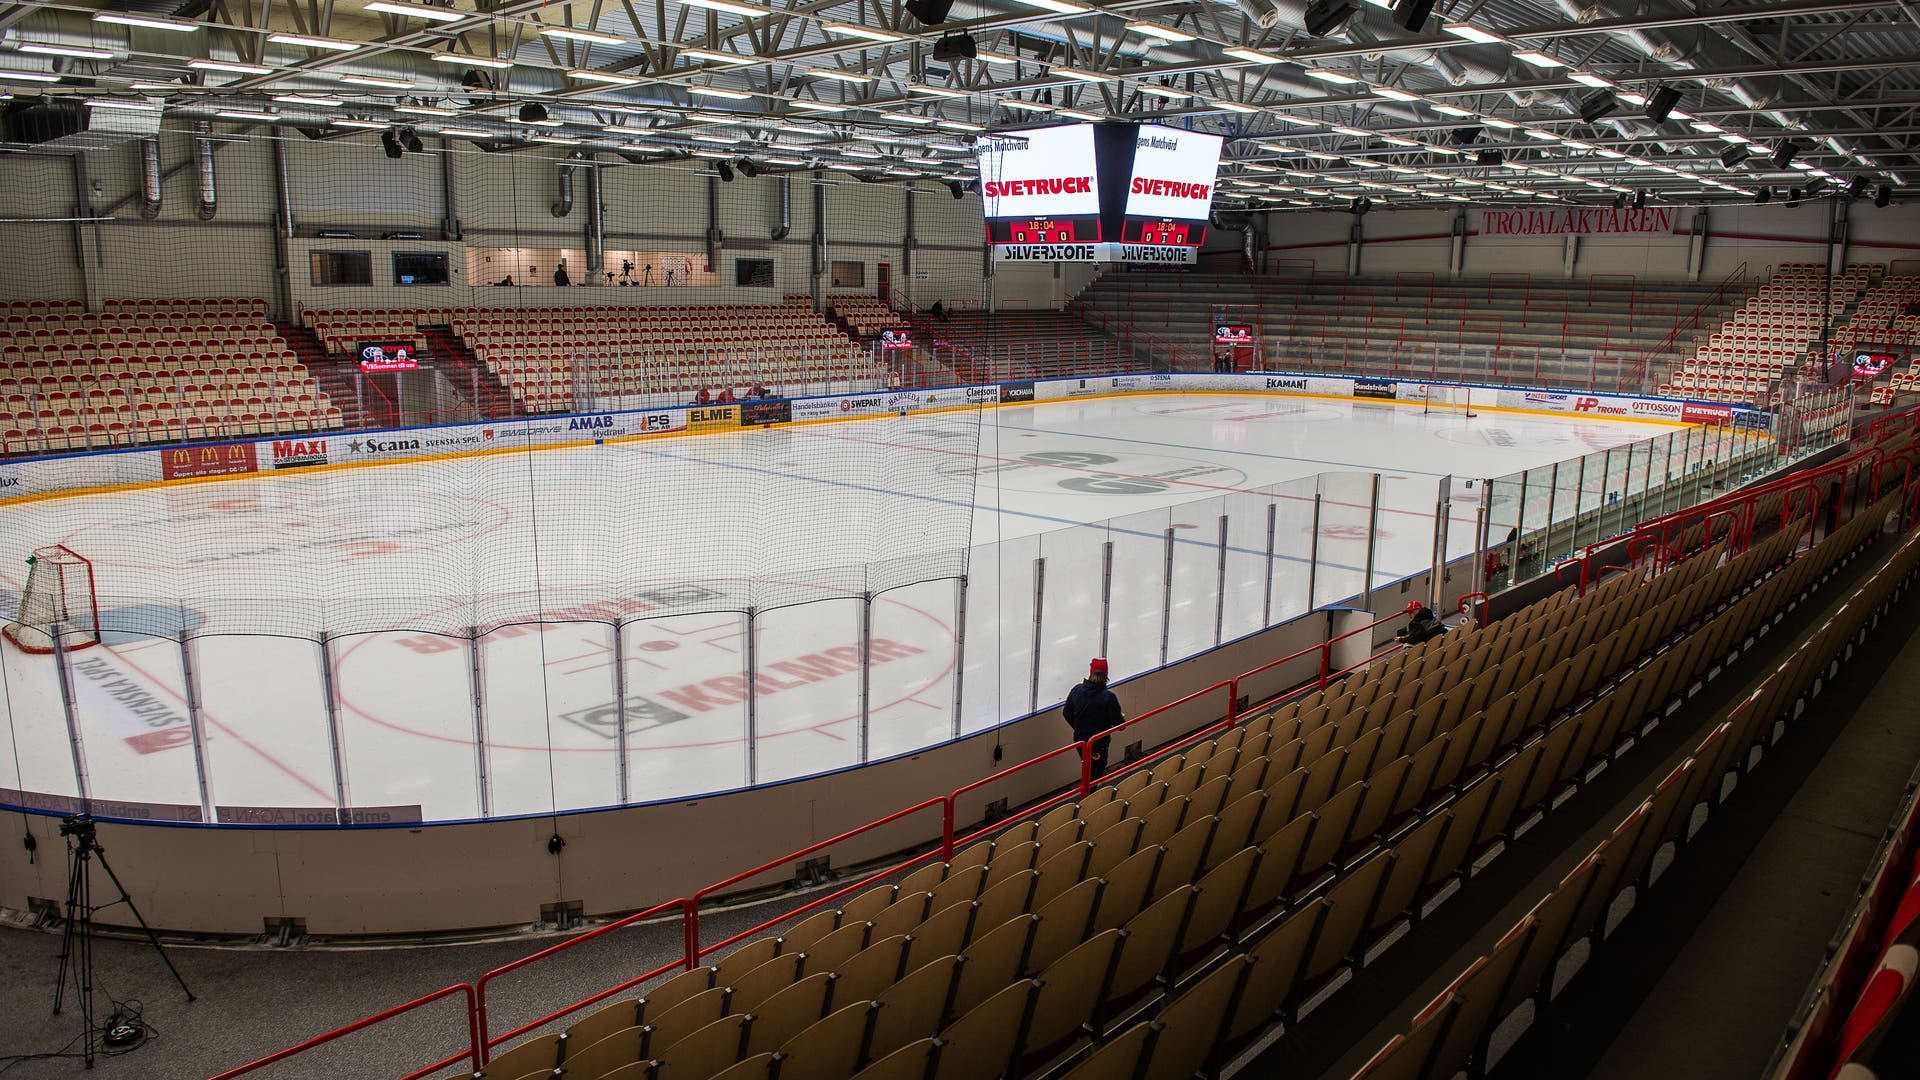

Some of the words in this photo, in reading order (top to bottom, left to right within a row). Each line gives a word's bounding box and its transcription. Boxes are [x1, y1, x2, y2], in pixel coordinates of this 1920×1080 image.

[985, 176, 1091, 197] SVETRUCK
[1131, 177, 1210, 200] SVETRUCK
[1029, 221, 1054, 230] 18:04
[1156, 222, 1176, 232] 18:04
[1018, 232, 1024, 241] 0
[1060, 231, 1067, 241] 0
[1145, 232, 1152, 242] 0
[1176, 234, 1182, 243] 0
[381, 345, 414, 353] TOYOTA
[1265, 378, 1308, 390] EKAMANT
[1353, 382, 1388, 392] Sundström
[966, 388, 997, 397] Claessons
[1008, 388, 1034, 396] YOKOHAMA
[1531, 393, 1568, 401] INTERSPORT
[792, 401, 838, 411] Handelsbanken
[851, 398, 882, 408] SWEPART
[1574, 397, 1599, 412] HP
[1632, 402, 1681, 413] OTTOSSON
[690, 408, 733, 422] ELME
[1597, 406, 1628, 415] TRONIC
[1685, 406, 1730, 417] SVETRUCK
[569, 416, 614, 430] AMAB
[648, 414, 670, 426] PS
[500, 425, 562, 437] SWEDRIVE
[366, 438, 420, 453] Scana
[425, 438, 461, 447] SVENSKA
[462, 436, 481, 444] SPEL
[272, 440, 327, 458] MAXI
[656, 637, 927, 714] KALMAR
[101, 678, 188, 728] SVENSKA
